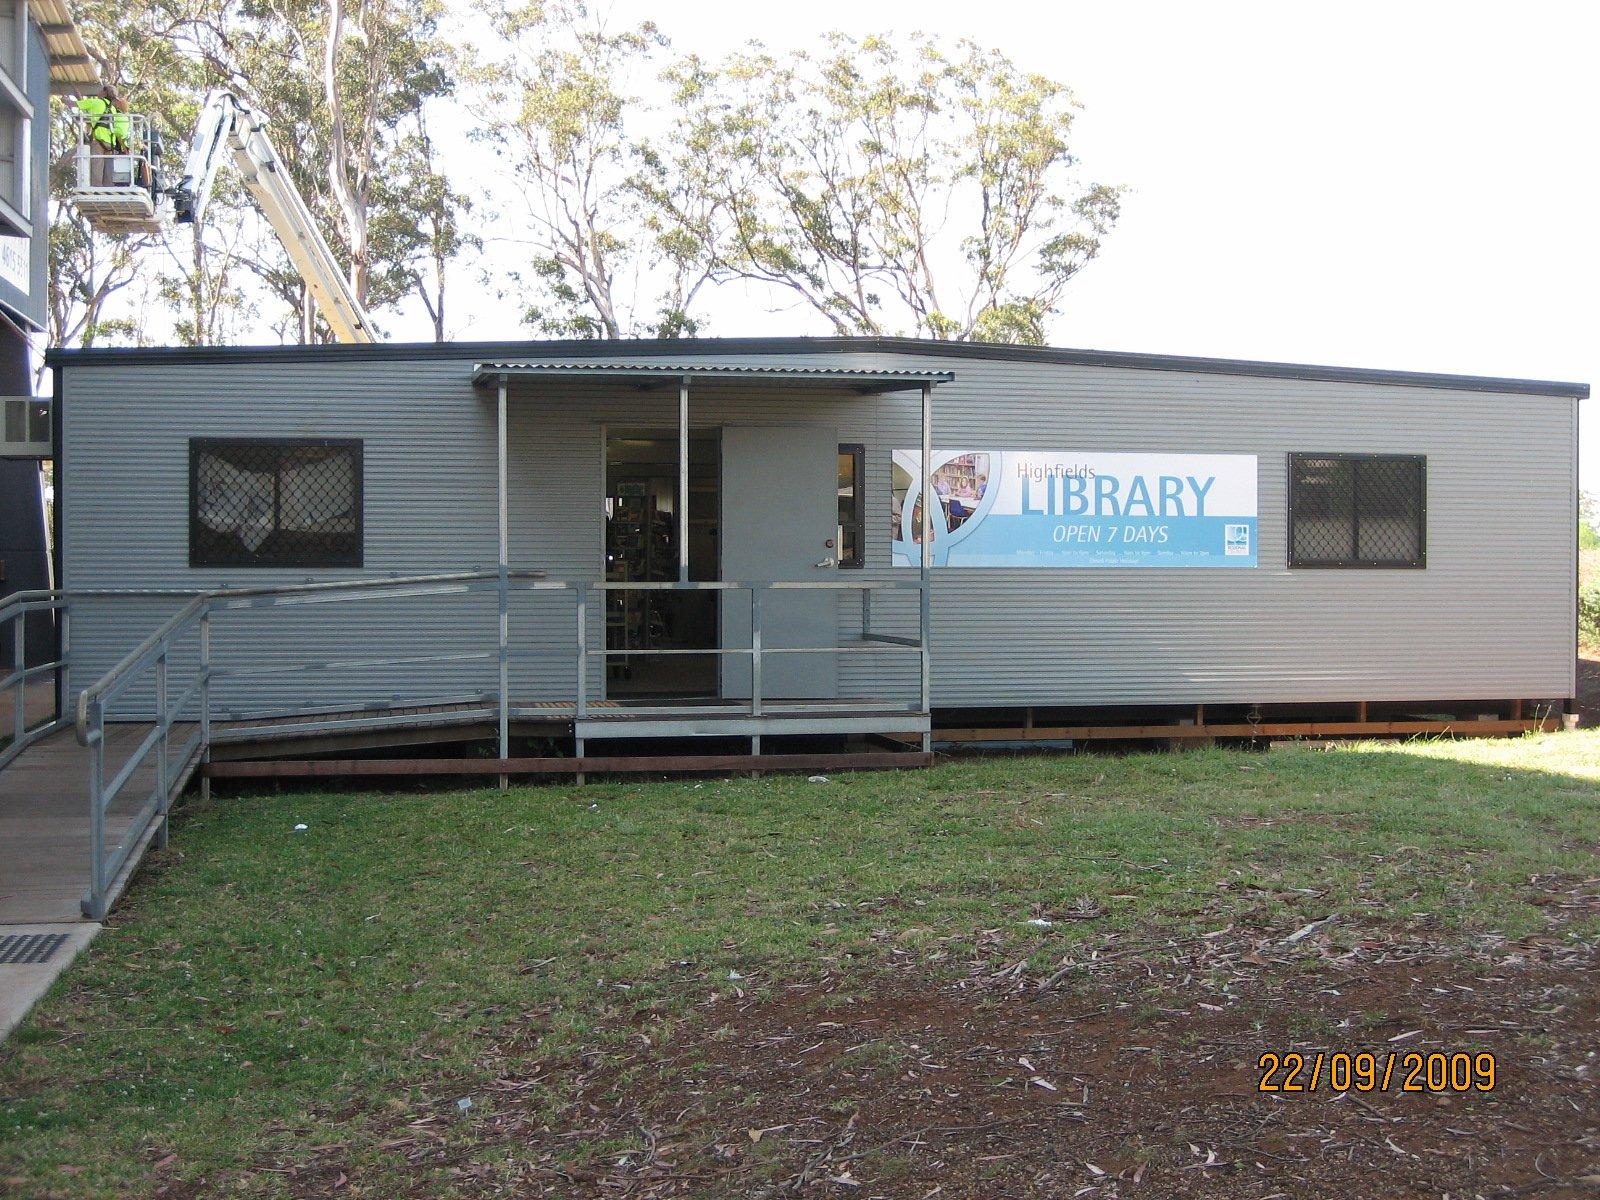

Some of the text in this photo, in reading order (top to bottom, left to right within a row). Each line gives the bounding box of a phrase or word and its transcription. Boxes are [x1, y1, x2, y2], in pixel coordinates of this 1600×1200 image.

[1016, 462, 1096, 482] Highfields
[1021, 475, 1216, 516] LIBRARY
[1053, 525, 1169, 543] OPEN 7 DAYS
